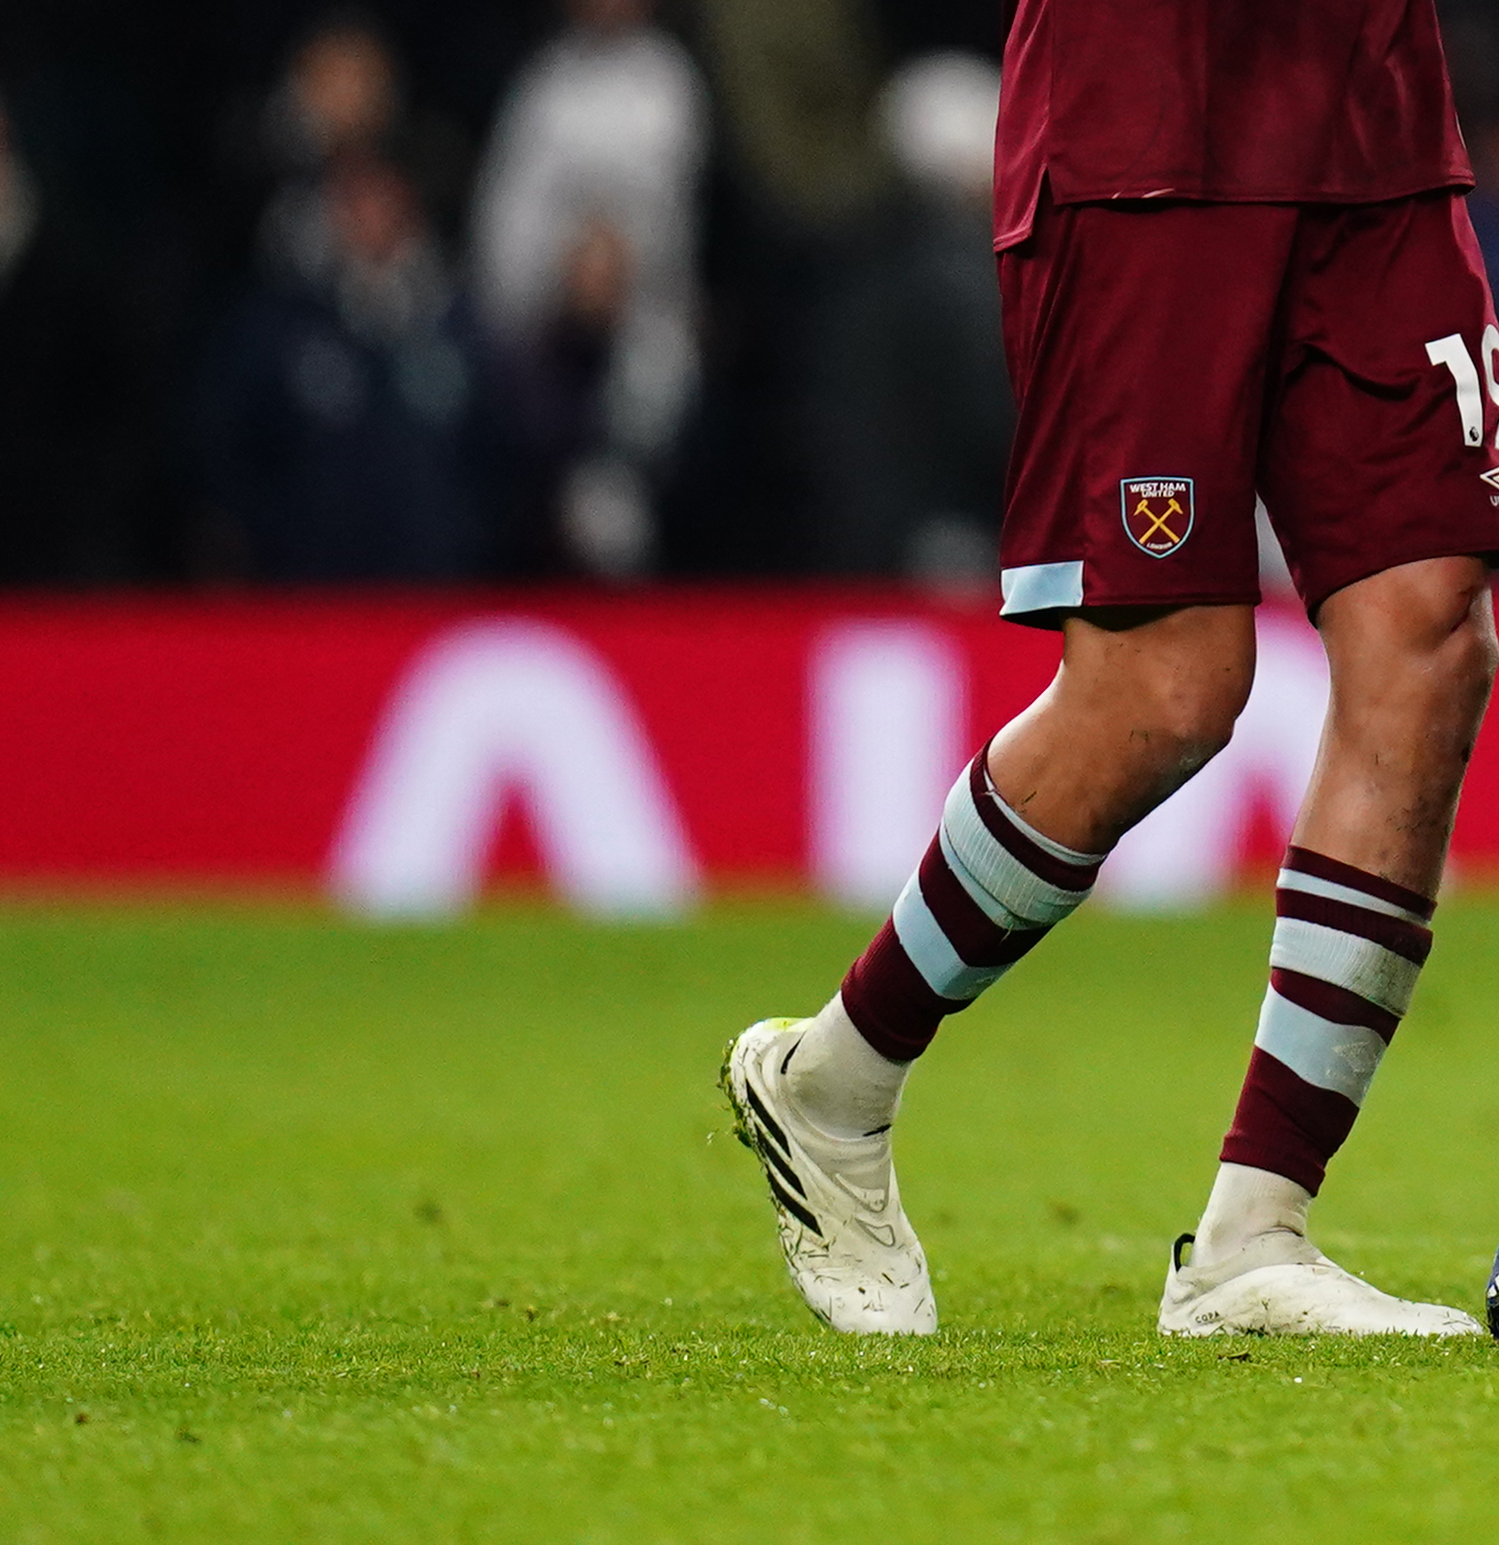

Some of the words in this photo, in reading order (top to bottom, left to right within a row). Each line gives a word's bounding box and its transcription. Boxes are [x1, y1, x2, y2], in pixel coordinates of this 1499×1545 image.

[1129, 482, 1158, 493] WEST
[1160, 482, 1186, 492] HAM
[1141, 490, 1175, 498] UNITED
